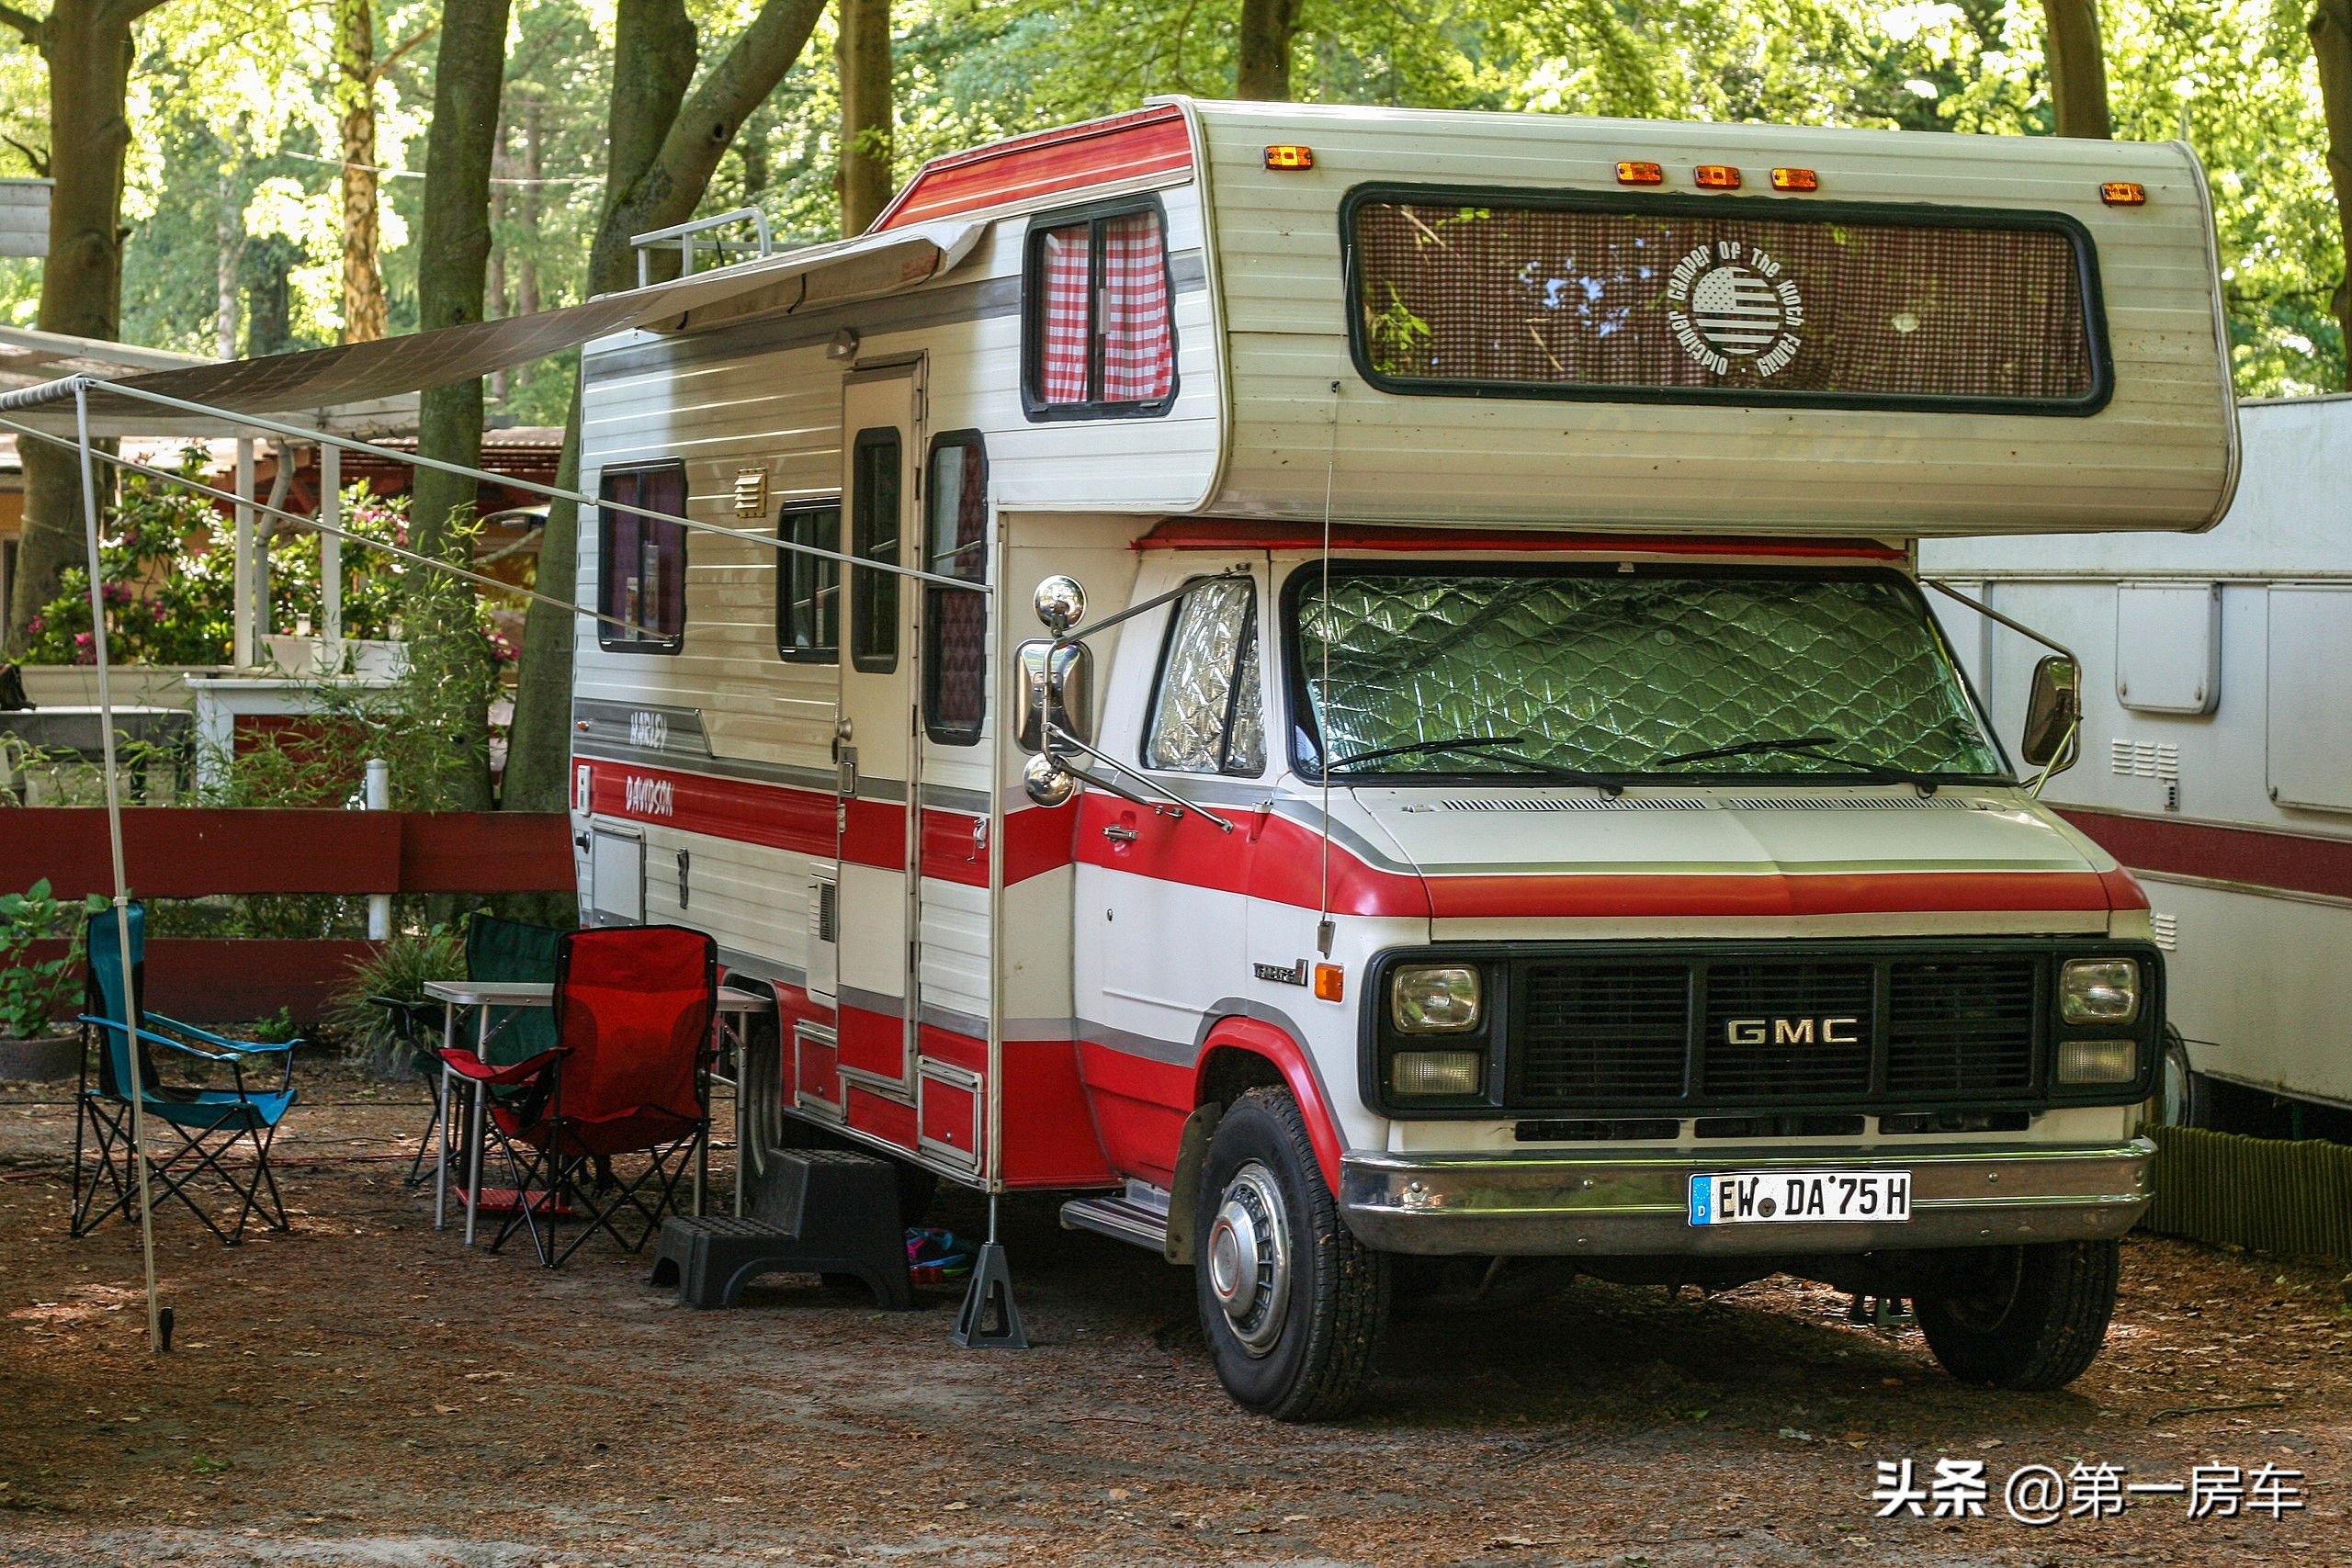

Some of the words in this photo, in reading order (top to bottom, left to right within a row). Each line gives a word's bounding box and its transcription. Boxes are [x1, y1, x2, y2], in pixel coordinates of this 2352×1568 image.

[1718, 241, 1741, 260] Of
[1750, 247, 1781, 277] The
[1667, 244, 1711, 301] Camper
[1776, 279, 1804, 326] Kloth
[1668, 310, 1728, 376] Oldtimer
[1756, 333, 1802, 378] Family
[630, 712, 668, 753] HARLEY
[626, 775, 674, 817] DAVIDSON
[1727, 1018, 1858, 1044] GMC
[1697, 1205, 1706, 1217] D
[1719, 1179, 1758, 1218] EW
[1785, 1179, 1825, 1215] DA
